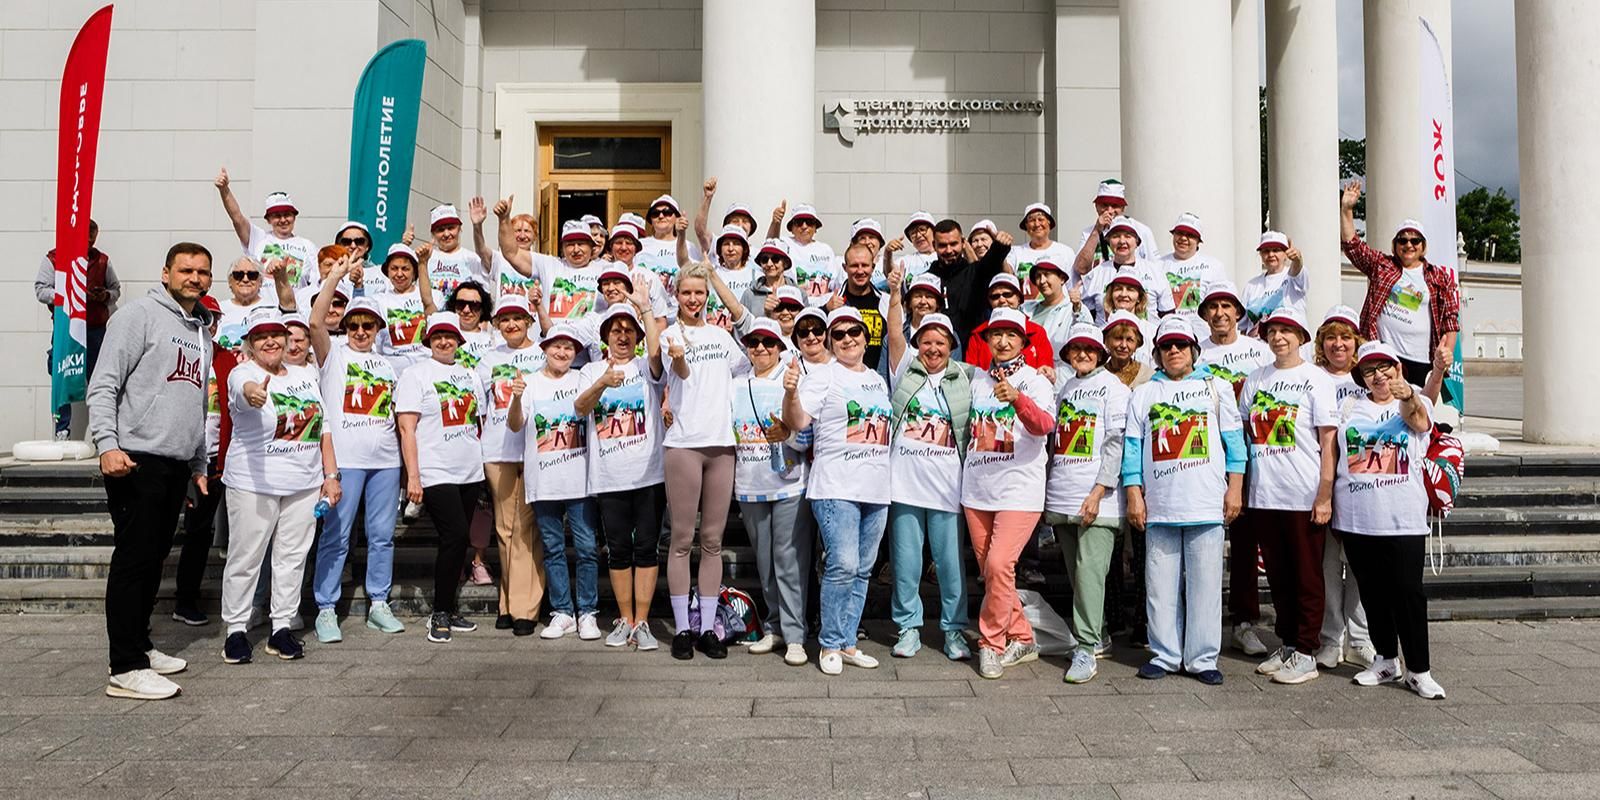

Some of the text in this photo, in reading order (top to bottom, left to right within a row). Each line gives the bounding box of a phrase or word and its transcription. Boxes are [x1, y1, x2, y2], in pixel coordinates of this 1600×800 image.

[375, 96, 395, 232] ДОЛГОЛЕТИЕ
[1432, 118, 1447, 202] ЗОЖ
[511, 352, 546, 364] Москв
[1222, 348, 1261, 366] Москва
[1070, 385, 1107, 402] Москв
[1270, 379, 1313, 392] Москва
[1172, 388, 1212, 404] Москв
